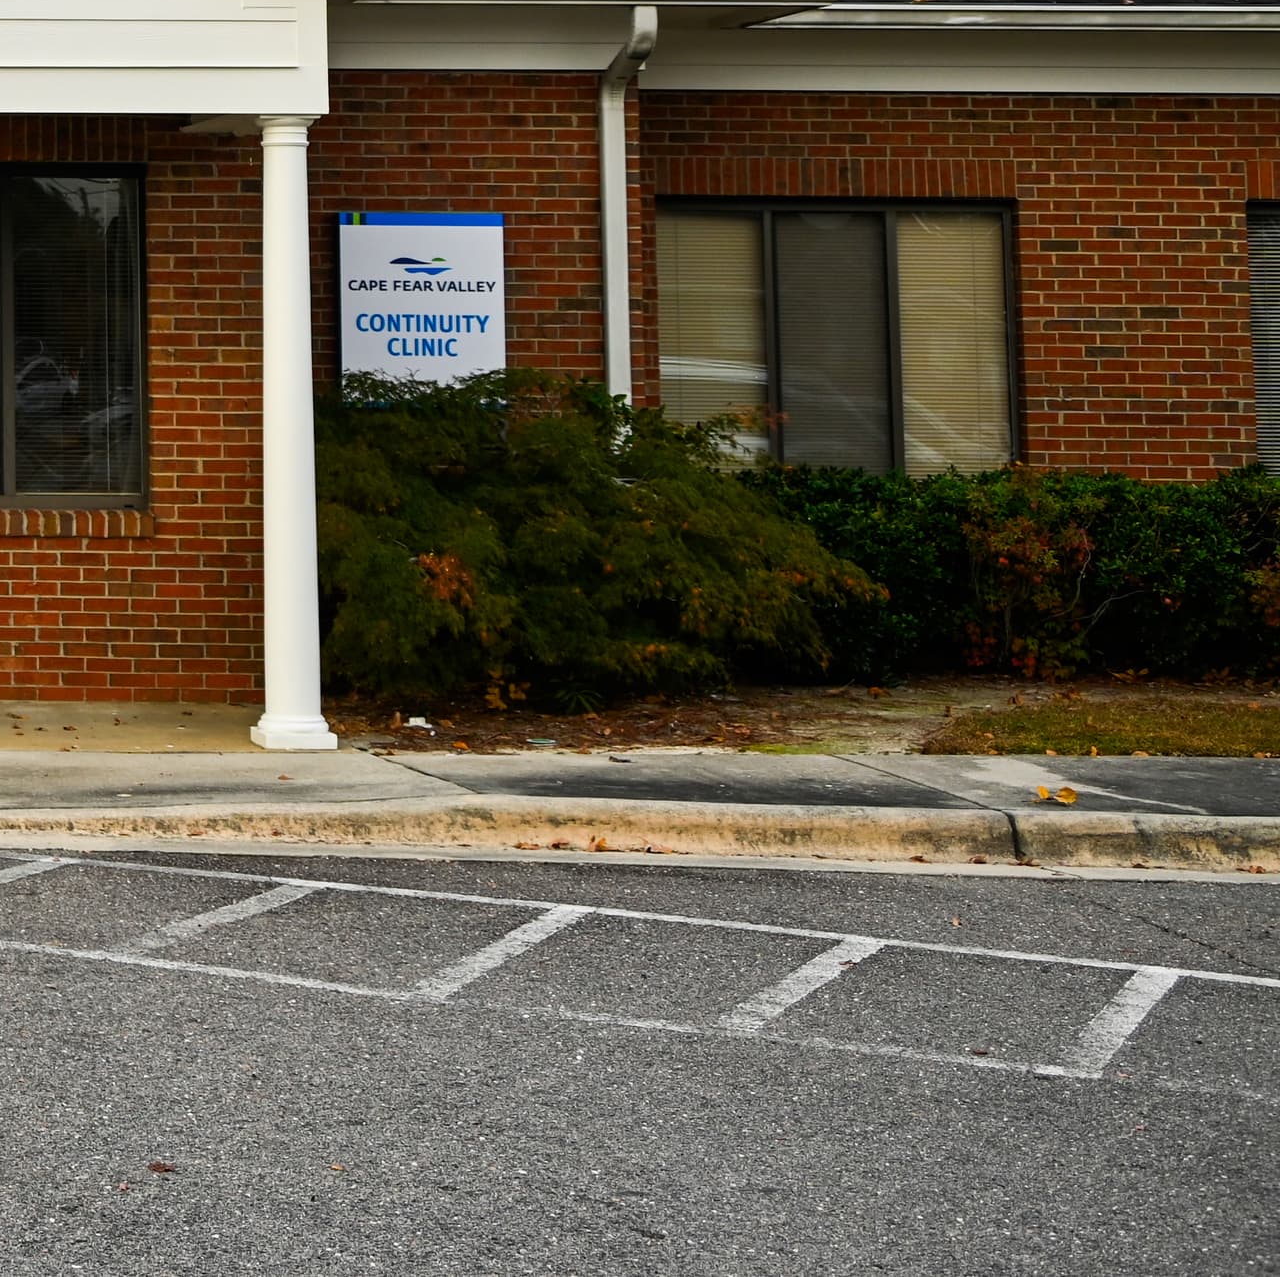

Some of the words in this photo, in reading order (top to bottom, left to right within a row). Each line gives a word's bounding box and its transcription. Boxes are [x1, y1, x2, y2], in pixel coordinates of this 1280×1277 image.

[348, 279, 388, 292] CAPE
[393, 280, 434, 292] FEAR
[436, 280, 496, 293] VALLEY
[355, 313, 490, 334] CONTINUITY
[387, 338, 458, 357] CLINIC
